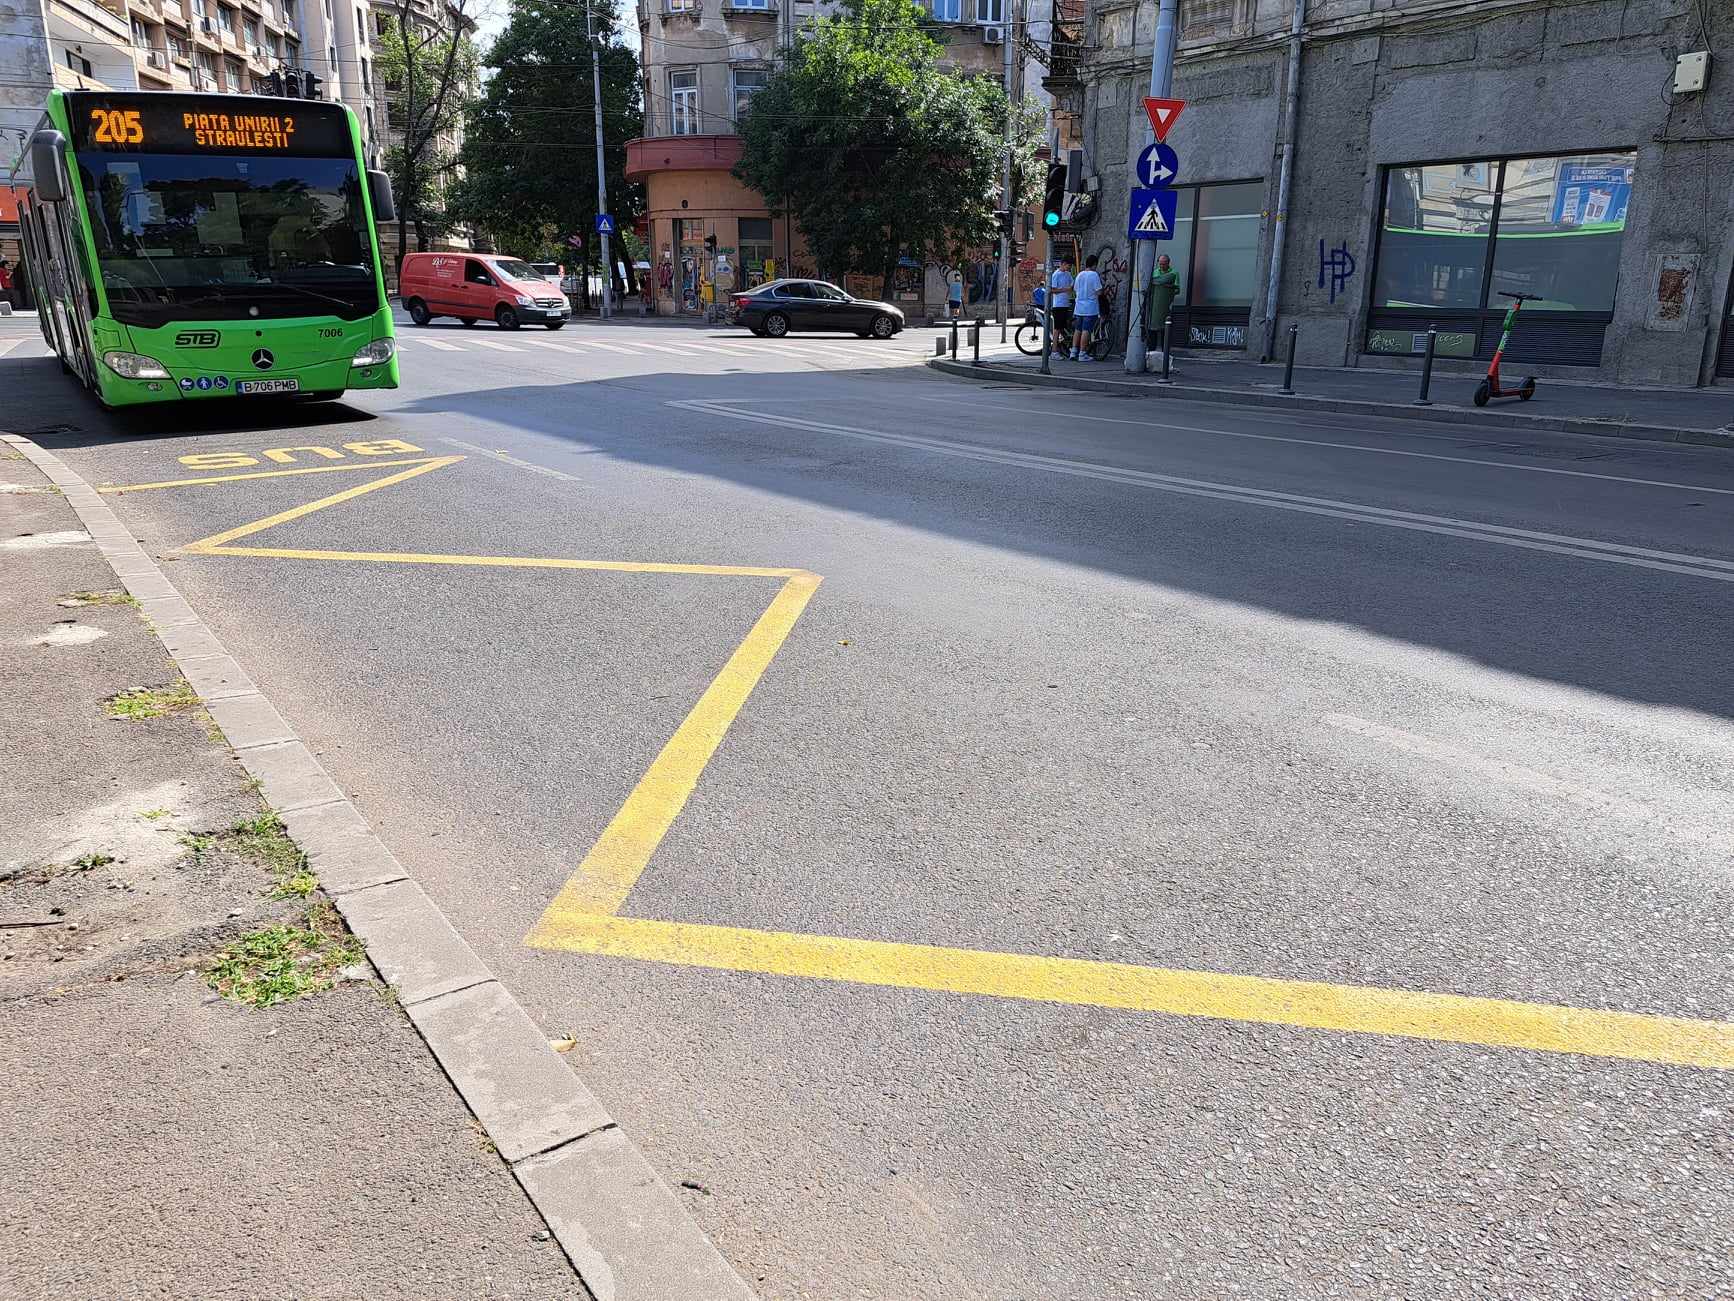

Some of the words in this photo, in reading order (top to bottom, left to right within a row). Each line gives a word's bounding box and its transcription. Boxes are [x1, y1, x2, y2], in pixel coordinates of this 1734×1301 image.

[91, 109, 144, 143] 205
[183, 113, 229, 131] PIATA
[234, 115, 280, 132] UNIRII
[284, 117, 295, 133] 2
[195, 129, 289, 148] STRAULESTI
[175, 331, 219, 347] STB
[318, 328, 343, 338] 7006
[244, 382, 252, 392] B
[254, 381, 273, 391] 706
[274, 380, 297, 391] PMB
[177, 439, 425, 470] BUS
